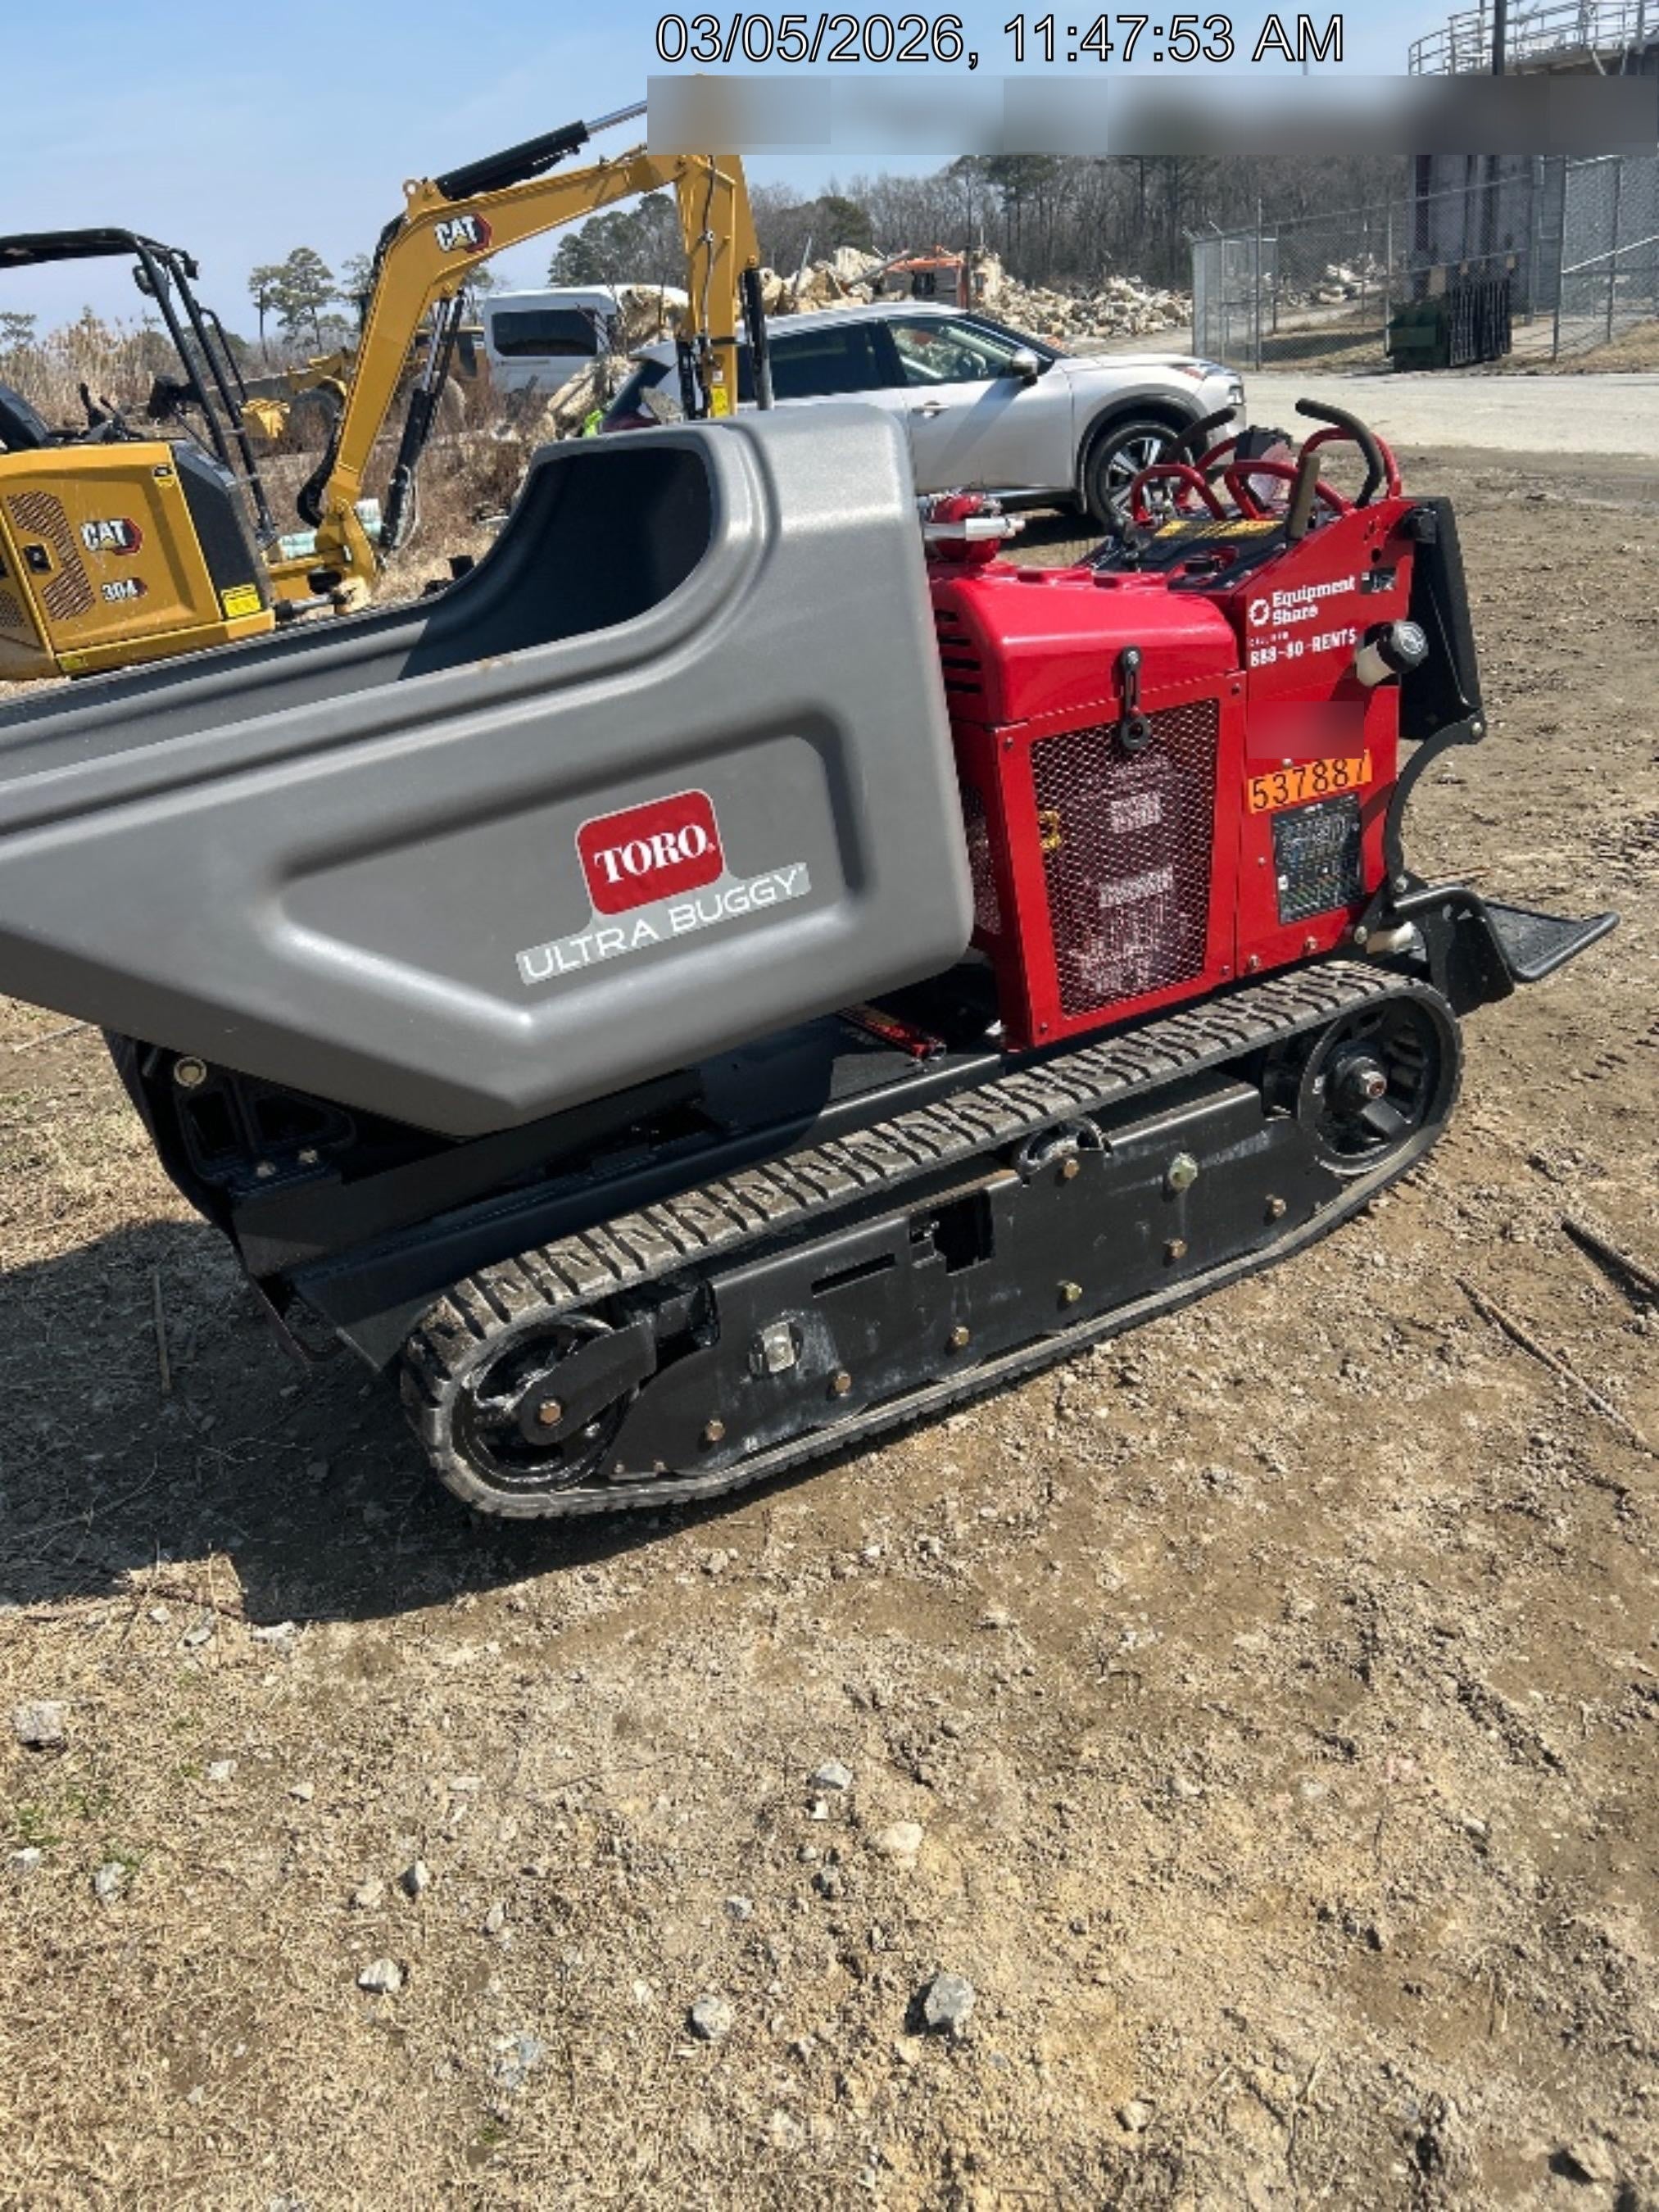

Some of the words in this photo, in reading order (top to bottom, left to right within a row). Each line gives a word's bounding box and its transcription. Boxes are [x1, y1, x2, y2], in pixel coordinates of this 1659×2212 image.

[434, 215, 478, 252] CAT
[81, 520, 128, 551] CAT
[102, 578, 138, 601] 304
[1272, 575, 1355, 608] Equipment
[1272, 605, 1318, 625] Share
[523, 918, 660, 977] ULTRA
